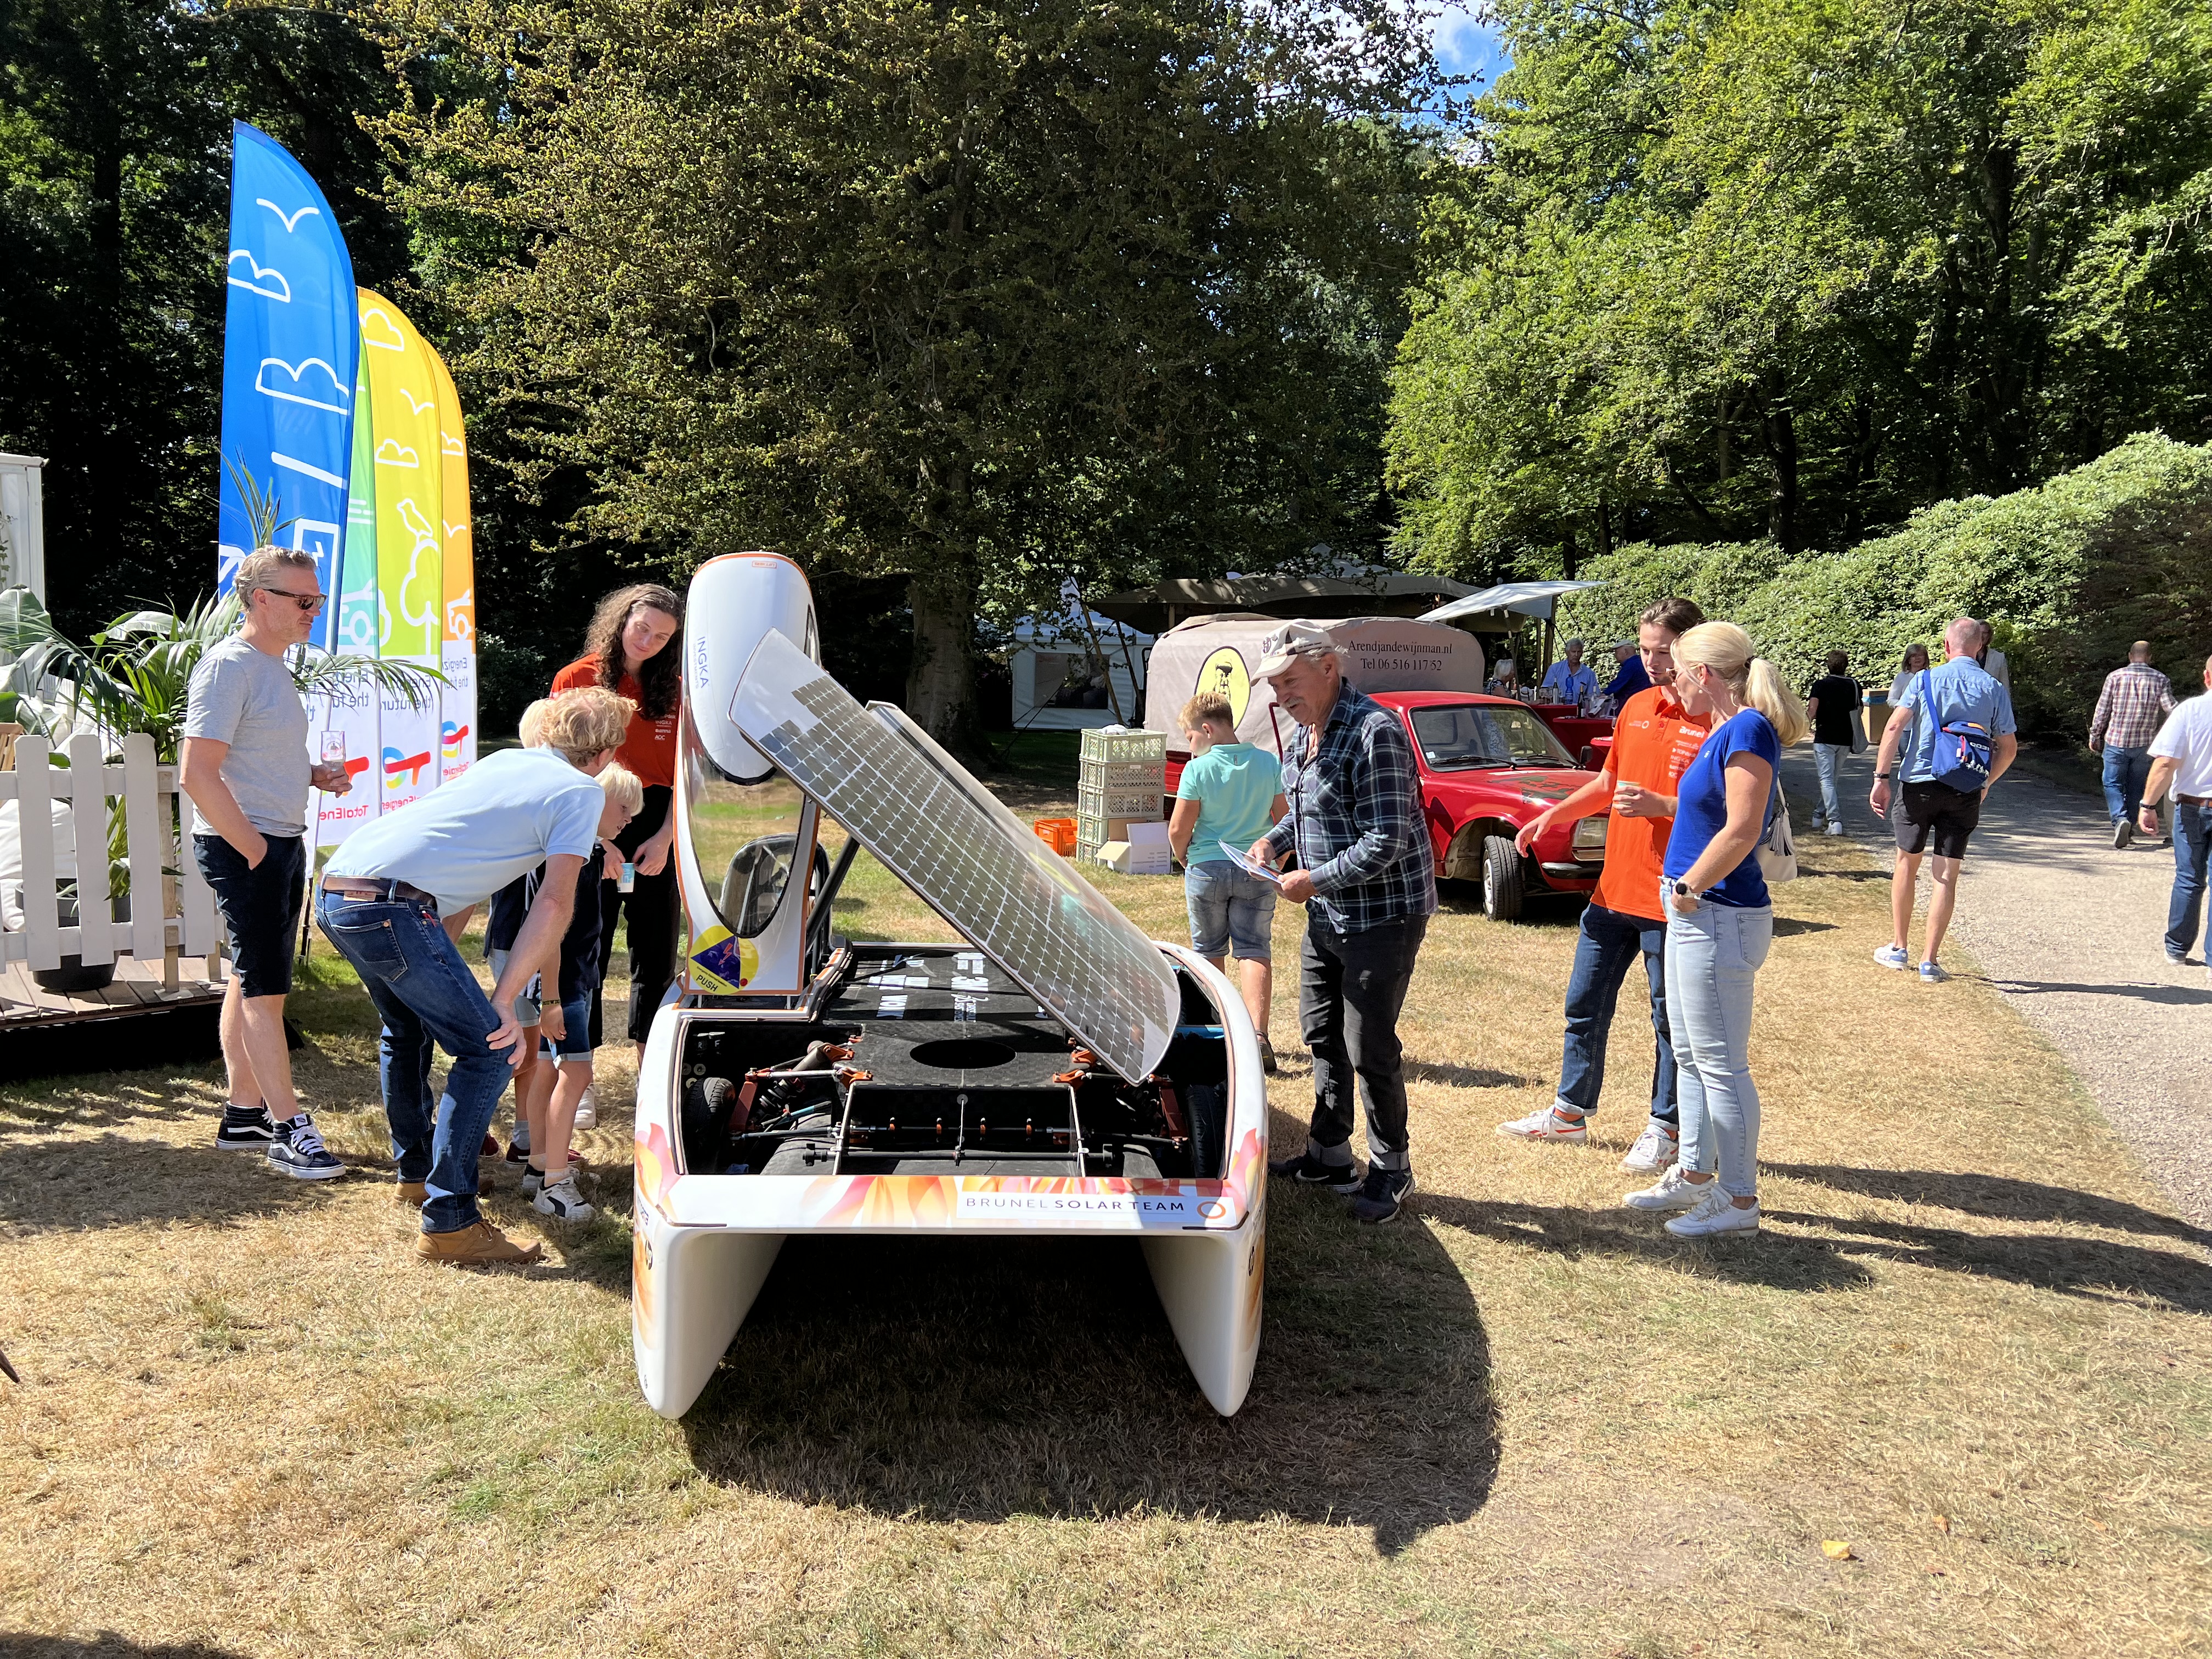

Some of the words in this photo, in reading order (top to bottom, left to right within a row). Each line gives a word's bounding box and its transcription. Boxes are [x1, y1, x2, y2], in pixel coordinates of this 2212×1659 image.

[1348, 640, 1452, 655] Arendjandewijnman.nl
[697, 636, 708, 688] INGKA
[1361, 658, 1375, 669] Tel
[1378, 659, 1390, 669] 06
[1392, 659, 1409, 670] 516
[1413, 660, 1428, 670] 117
[1430, 660, 1442, 670] 52
[1679, 726, 1706, 738] Brunel
[1670, 755, 1690, 764] INGKA
[696, 974, 718, 992] PUSH
[951, 976, 989, 991] 3M
[967, 1198, 1047, 1208] BRUNEL
[1055, 1200, 1122, 1210] SOLAR
[1128, 1201, 1184, 1211] TEAM
